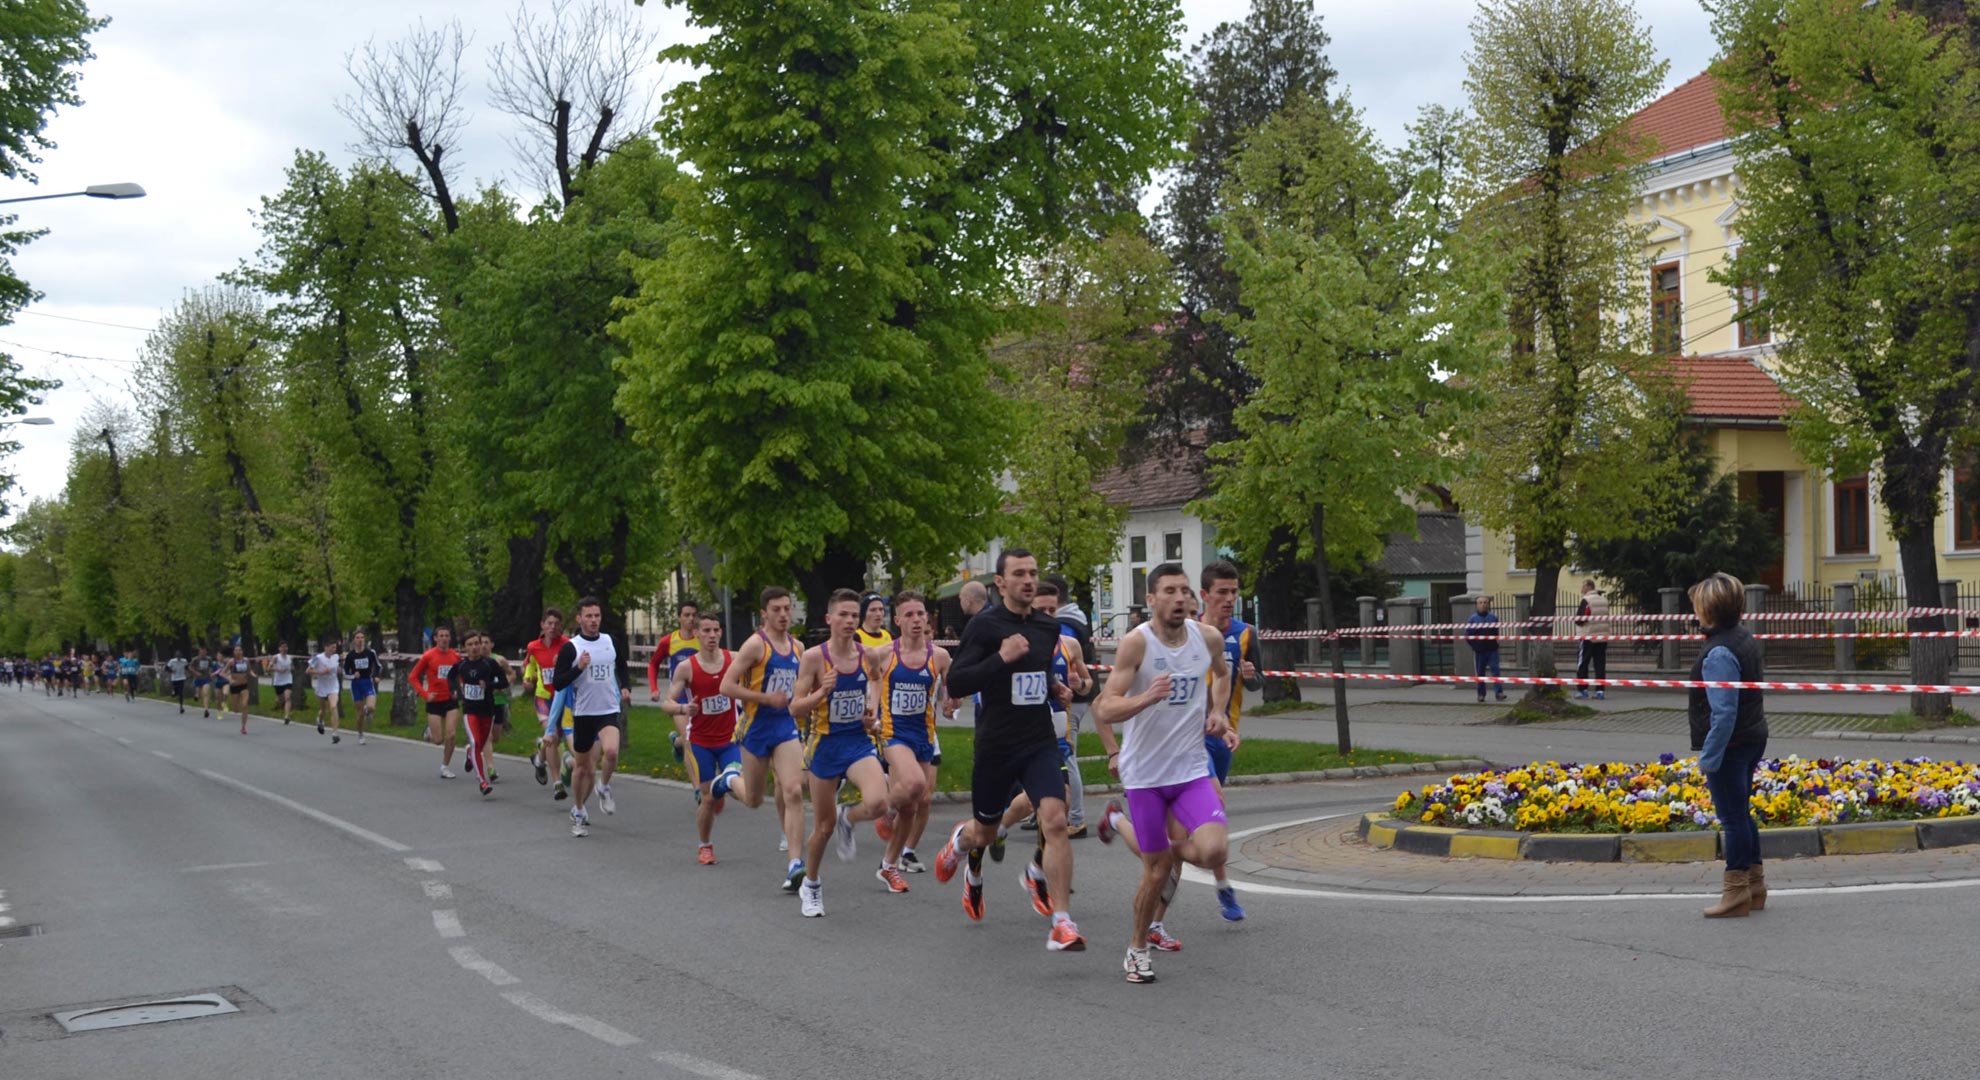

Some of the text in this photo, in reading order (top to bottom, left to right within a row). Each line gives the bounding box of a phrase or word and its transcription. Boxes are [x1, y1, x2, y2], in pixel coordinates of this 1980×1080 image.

[590, 664, 610, 678] 1351
[895, 682, 926, 691] ROMANIA
[1163, 677, 1198, 701] 337
[704, 695, 728, 710] 1199
[834, 696, 863, 716] 1306
[896, 692, 925, 709] 1309
